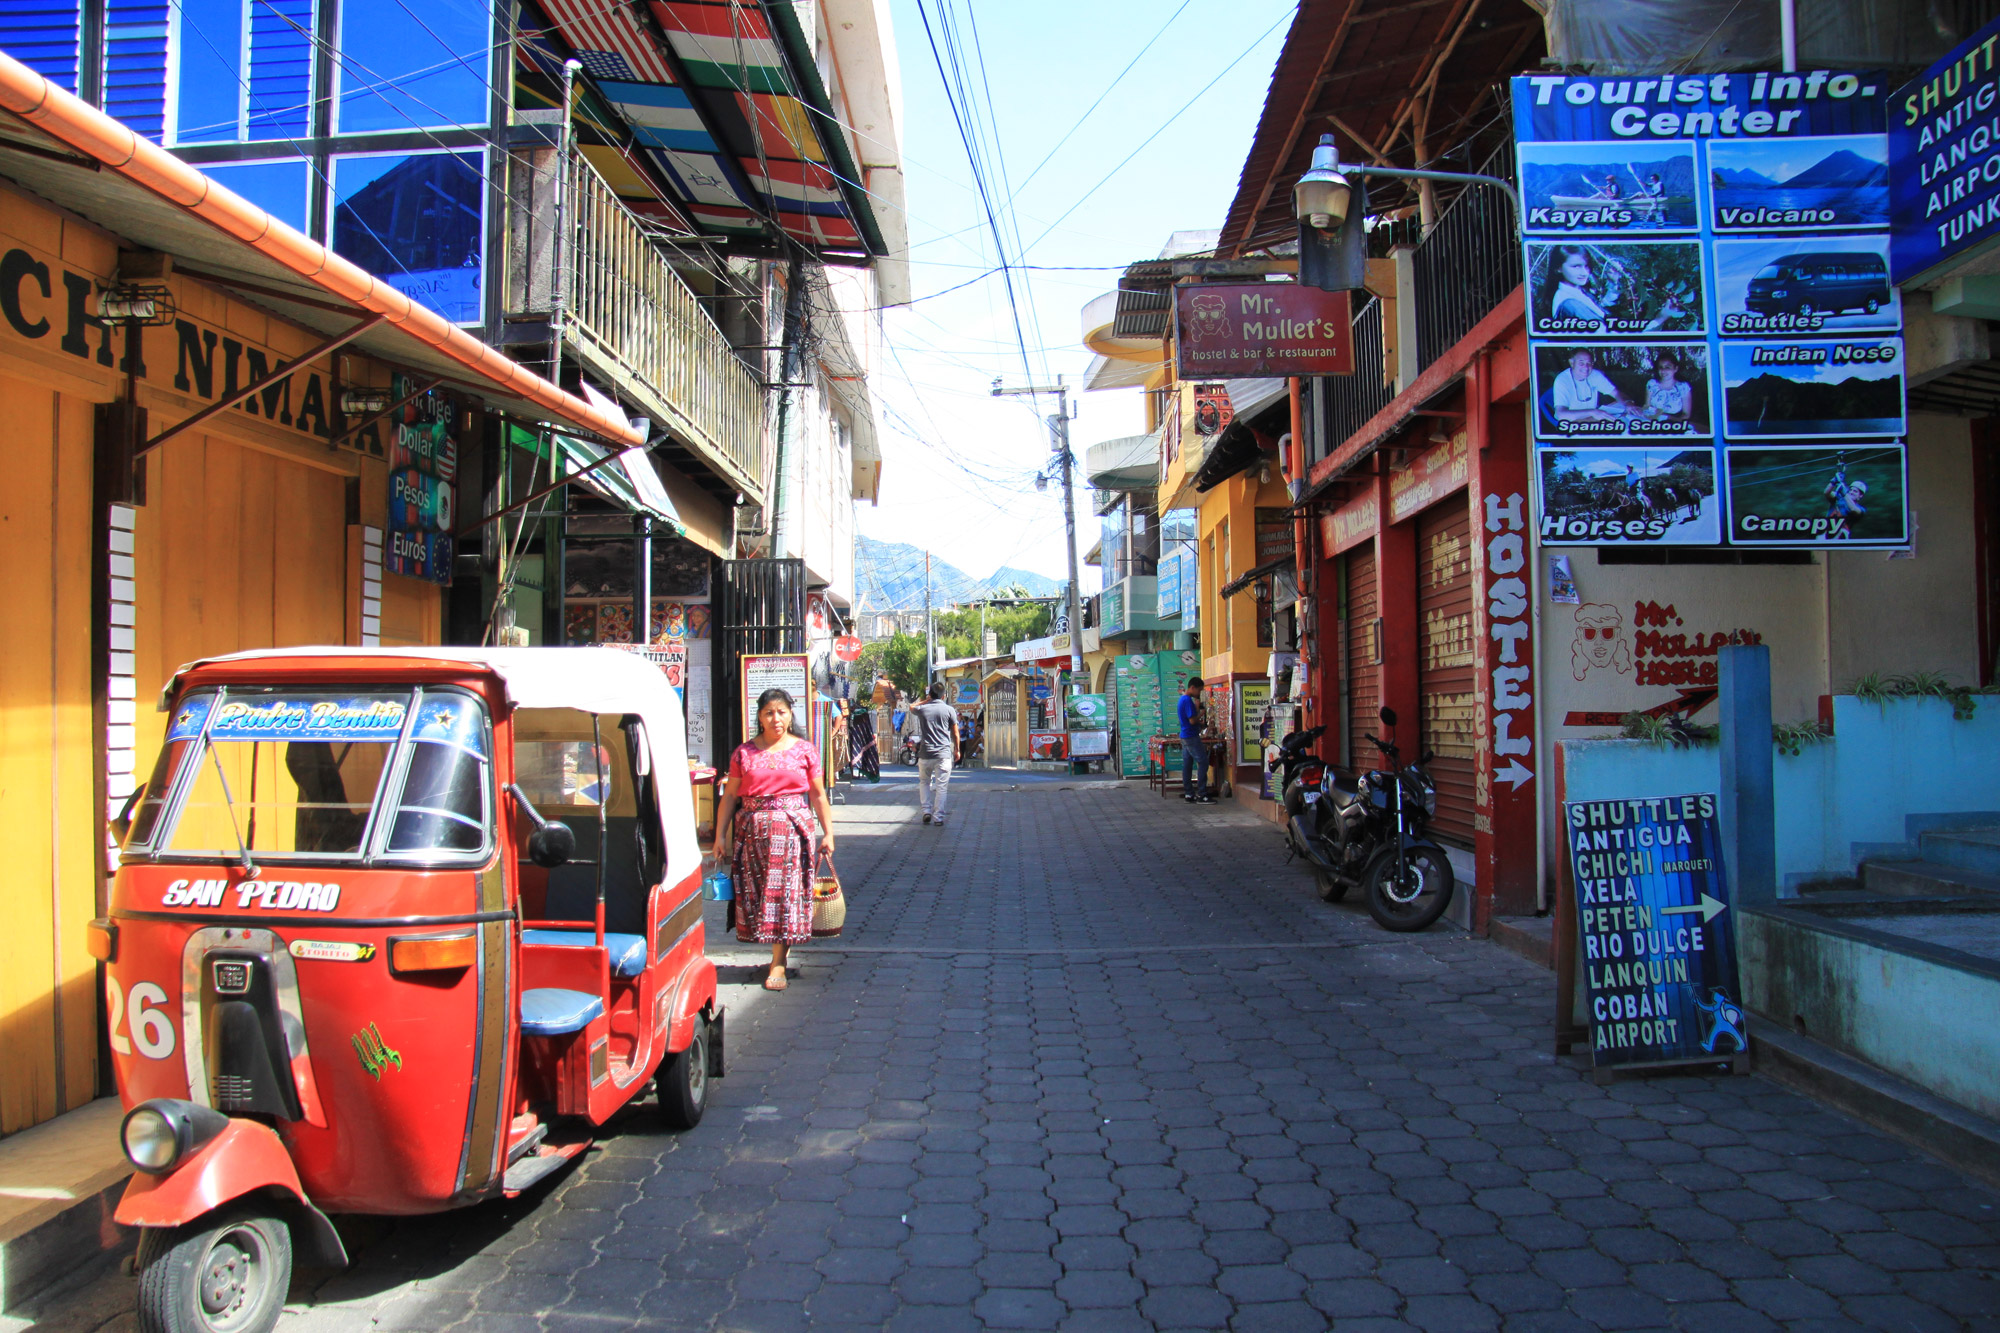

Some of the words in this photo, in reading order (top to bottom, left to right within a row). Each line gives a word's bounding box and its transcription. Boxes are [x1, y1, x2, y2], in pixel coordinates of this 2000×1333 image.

[1529, 74, 1730, 105] Tourist
[1750, 70, 1877, 101] info.
[1610, 104, 1801, 136] Center
[1917, 75, 2000, 153] ANTIG
[1529, 207, 1633, 228] Kayaks
[1720, 207, 1836, 225] Volcano
[1241, 293, 1281, 315] Mr.
[1243, 318, 1336, 341] Mullet's
[1538, 317, 1599, 331] Coffee
[1605, 317, 1649, 331] Tour
[1725, 314, 1824, 330] Shuttles
[1192, 348, 1227, 361] hostel
[1230, 348, 1240, 358] &
[1243, 347, 1261, 358] bar
[1266, 347, 1276, 357] &
[1279, 347, 1337, 358] restaurant
[1753, 347, 1827, 363] Indian
[1833, 345, 1896, 361] Nose
[174, 317, 384, 457] NIMAA
[401, 375, 452, 425] Chnge
[398, 423, 433, 458] Dollar
[1558, 420, 1625, 435] Spanish
[1630, 420, 1689, 432] School
[395, 476, 431, 509] Pesos
[1540, 516, 1667, 537] Horses
[1741, 514, 1845, 536] Canopy
[392, 531, 427, 562] Euros
[1483, 492, 1532, 757] HOSTEL
[1634, 600, 1684, 629] Mr.
[216, 702, 305, 729] Padre
[308, 702, 405, 729] Bendito
[1572, 796, 1714, 828] SHUTTLES
[1576, 824, 1692, 851] ANTIGUA
[1577, 850, 1653, 879] CHICHI
[1660, 858, 1713, 875] (MARQUET)
[163, 879, 228, 908] SAN
[235, 879, 342, 912] PEDRO
[1581, 877, 1638, 904] XELA
[1583, 900, 1654, 933] PETÉN
[1586, 933, 1623, 959] RIO
[1633, 927, 1705, 955] DULCE
[1589, 954, 1688, 990] LANQUÍN
[106, 975, 177, 1061] 26
[1593, 987, 1669, 1021] COBÁN
[1596, 1019, 1677, 1051] AIRPORT
